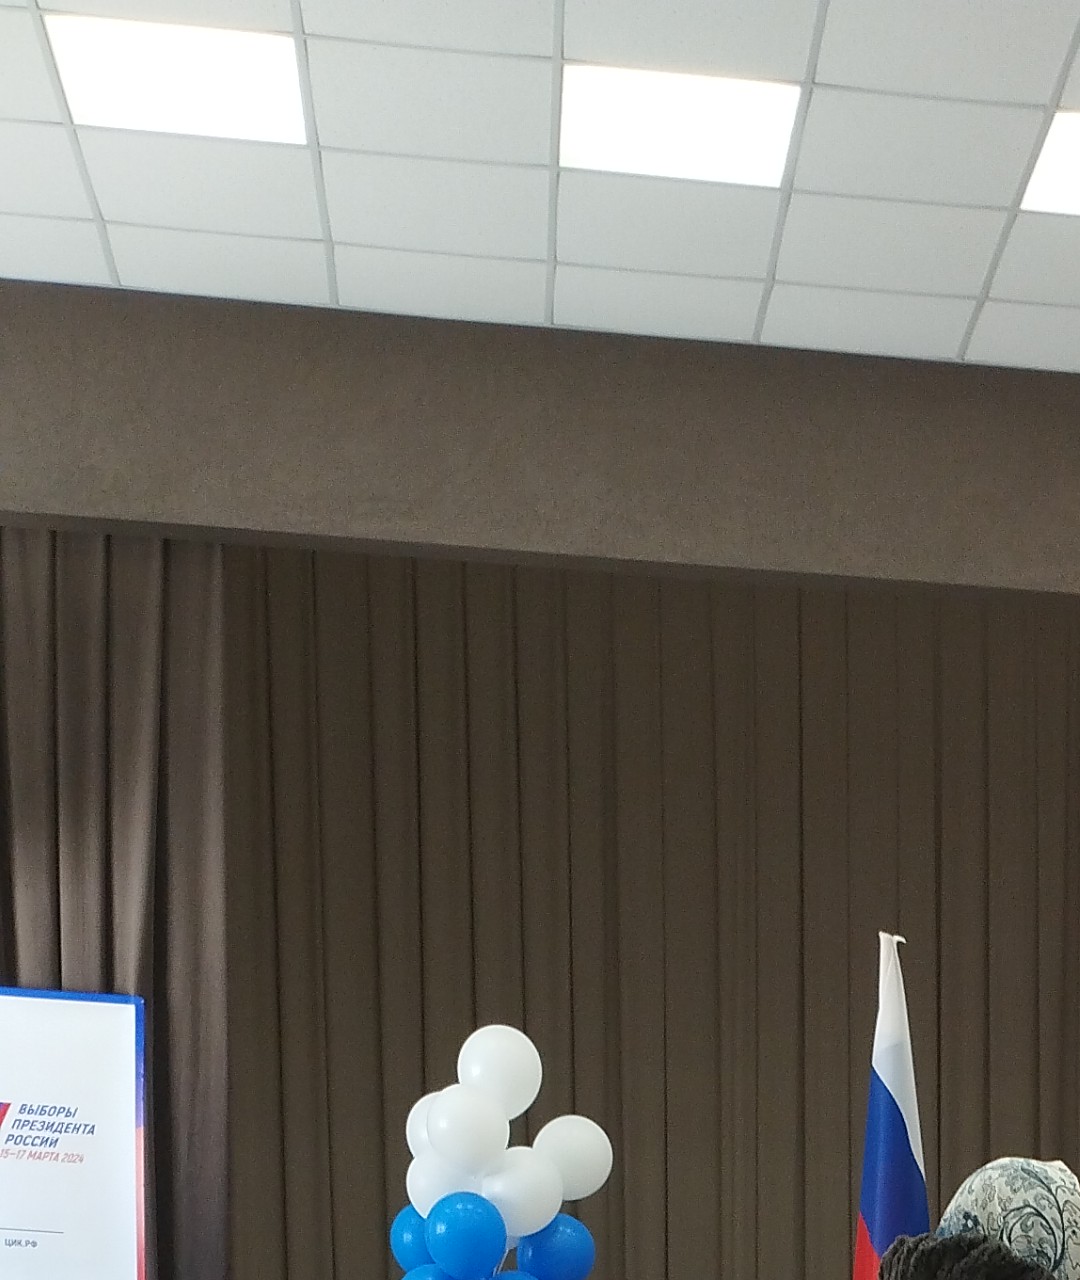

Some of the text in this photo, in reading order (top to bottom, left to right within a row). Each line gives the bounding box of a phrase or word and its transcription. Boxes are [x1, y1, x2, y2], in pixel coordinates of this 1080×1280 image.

[19, 1104, 78, 1118] ВЫБОРЫ
[11, 1119, 96, 1135] ПРЕЗИДЕНТА
[5, 1134, 60, 1148] РОССИИ
[27, 1151, 60, 1162] МАРТА
